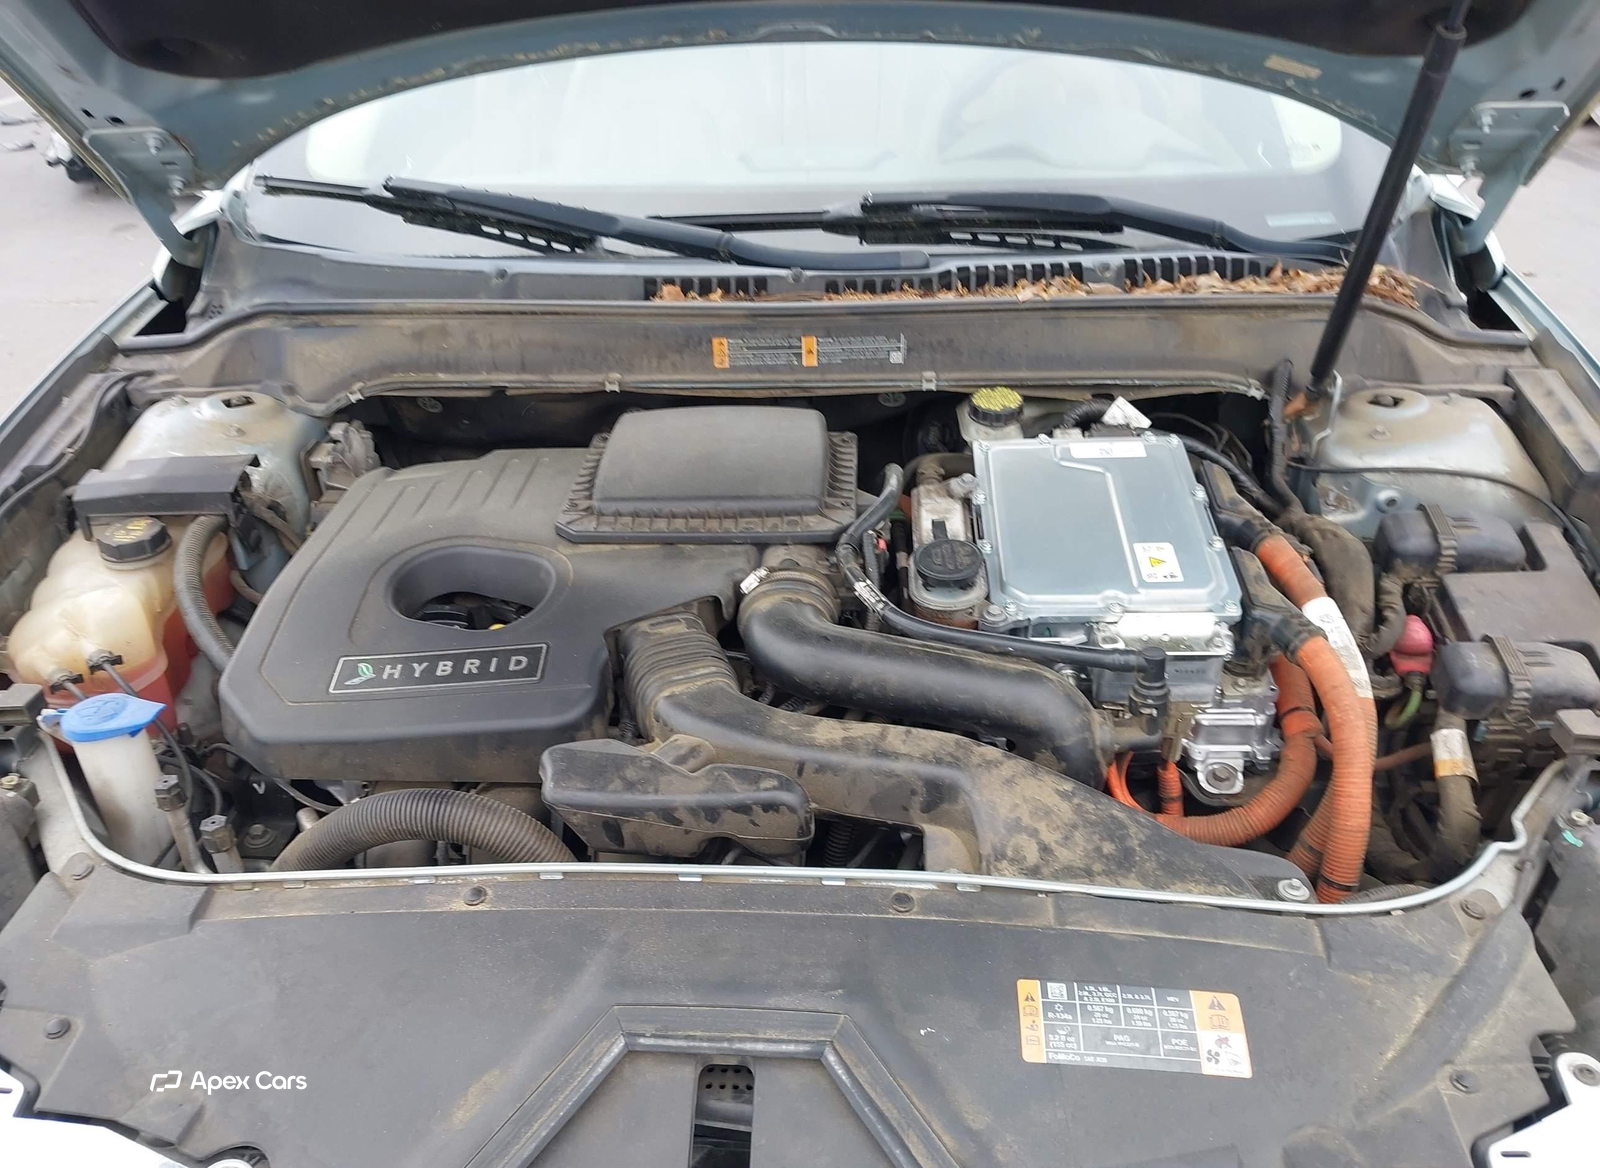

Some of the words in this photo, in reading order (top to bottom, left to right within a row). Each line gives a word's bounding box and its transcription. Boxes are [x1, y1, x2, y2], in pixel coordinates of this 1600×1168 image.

[382, 655, 528, 680] HYBRID
[1113, 1033, 1131, 1042] PAG
[1171, 1038, 1189, 1046] POE
[1048, 1052, 1081, 1061] FoMoCo
